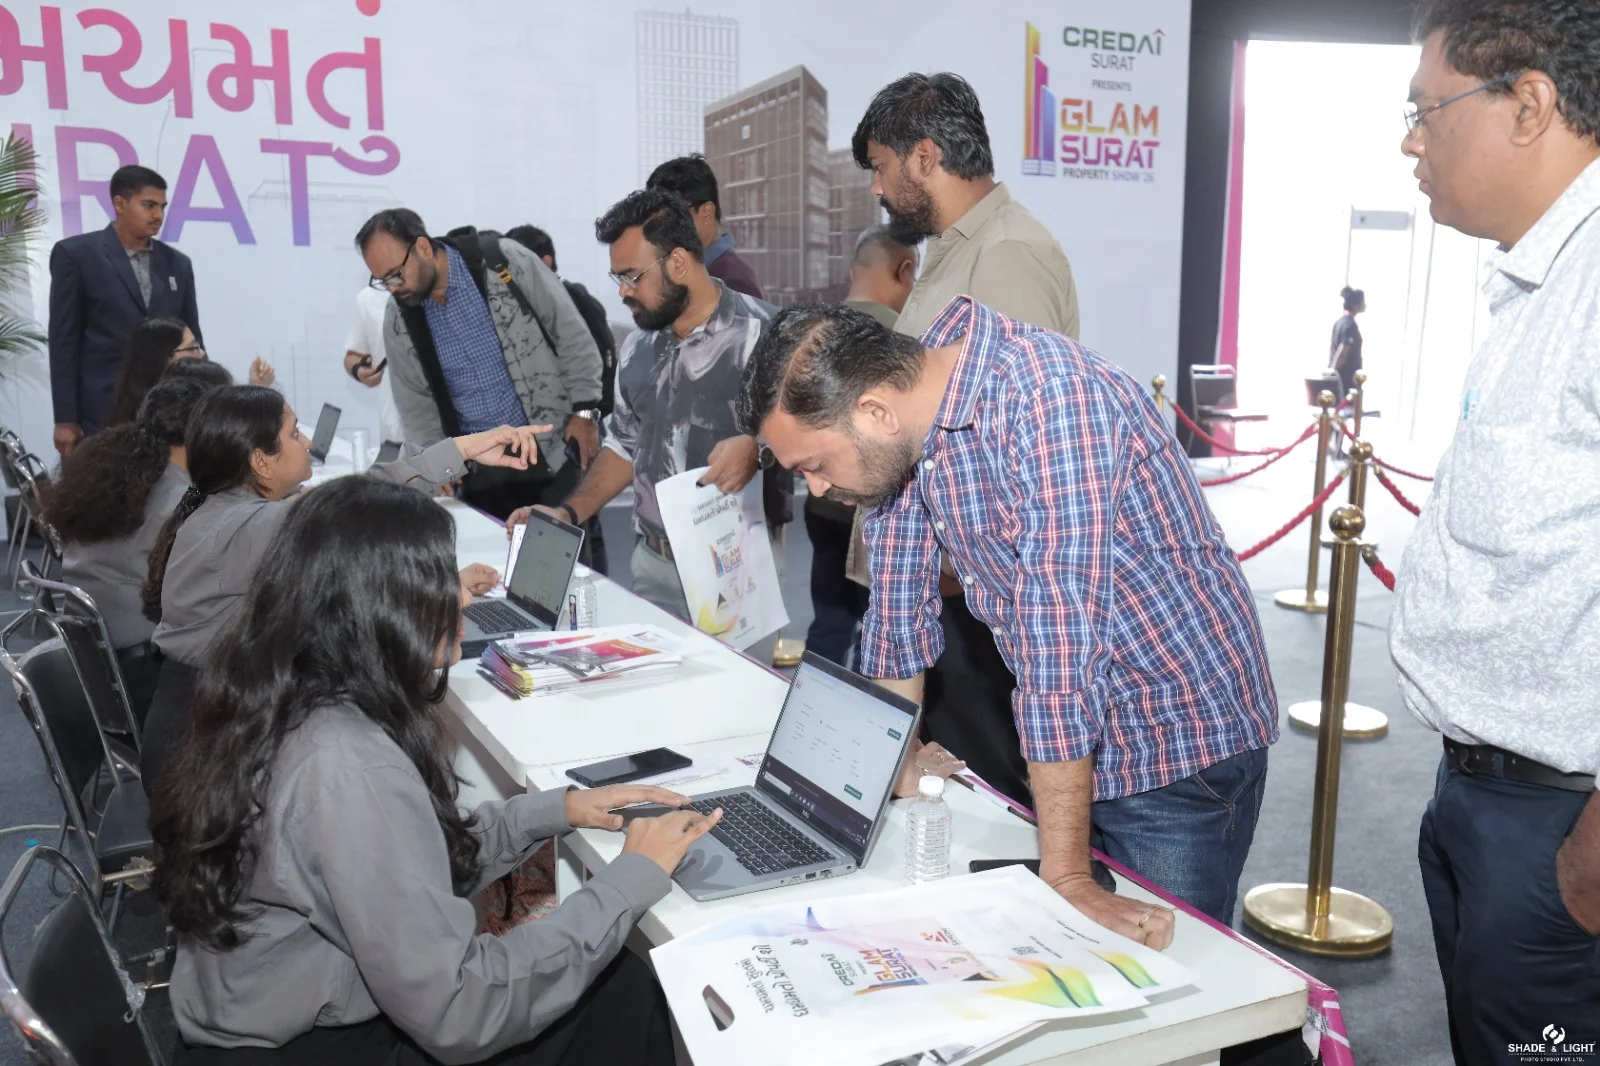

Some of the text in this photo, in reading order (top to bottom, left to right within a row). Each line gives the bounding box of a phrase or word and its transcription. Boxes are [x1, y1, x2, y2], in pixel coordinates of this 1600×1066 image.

[1091, 53, 1135, 71] SURAT
[1091, 79, 1132, 91] PRESENTS
[1060, 97, 1159, 138] GLAM
[1060, 135, 1160, 169] SURAT
[1063, 168, 1109, 180] PROPERTY
[1112, 170, 1140, 182] SHOW
[859, 948, 896, 982] GLAM
[875, 948, 912, 980] SURAT
